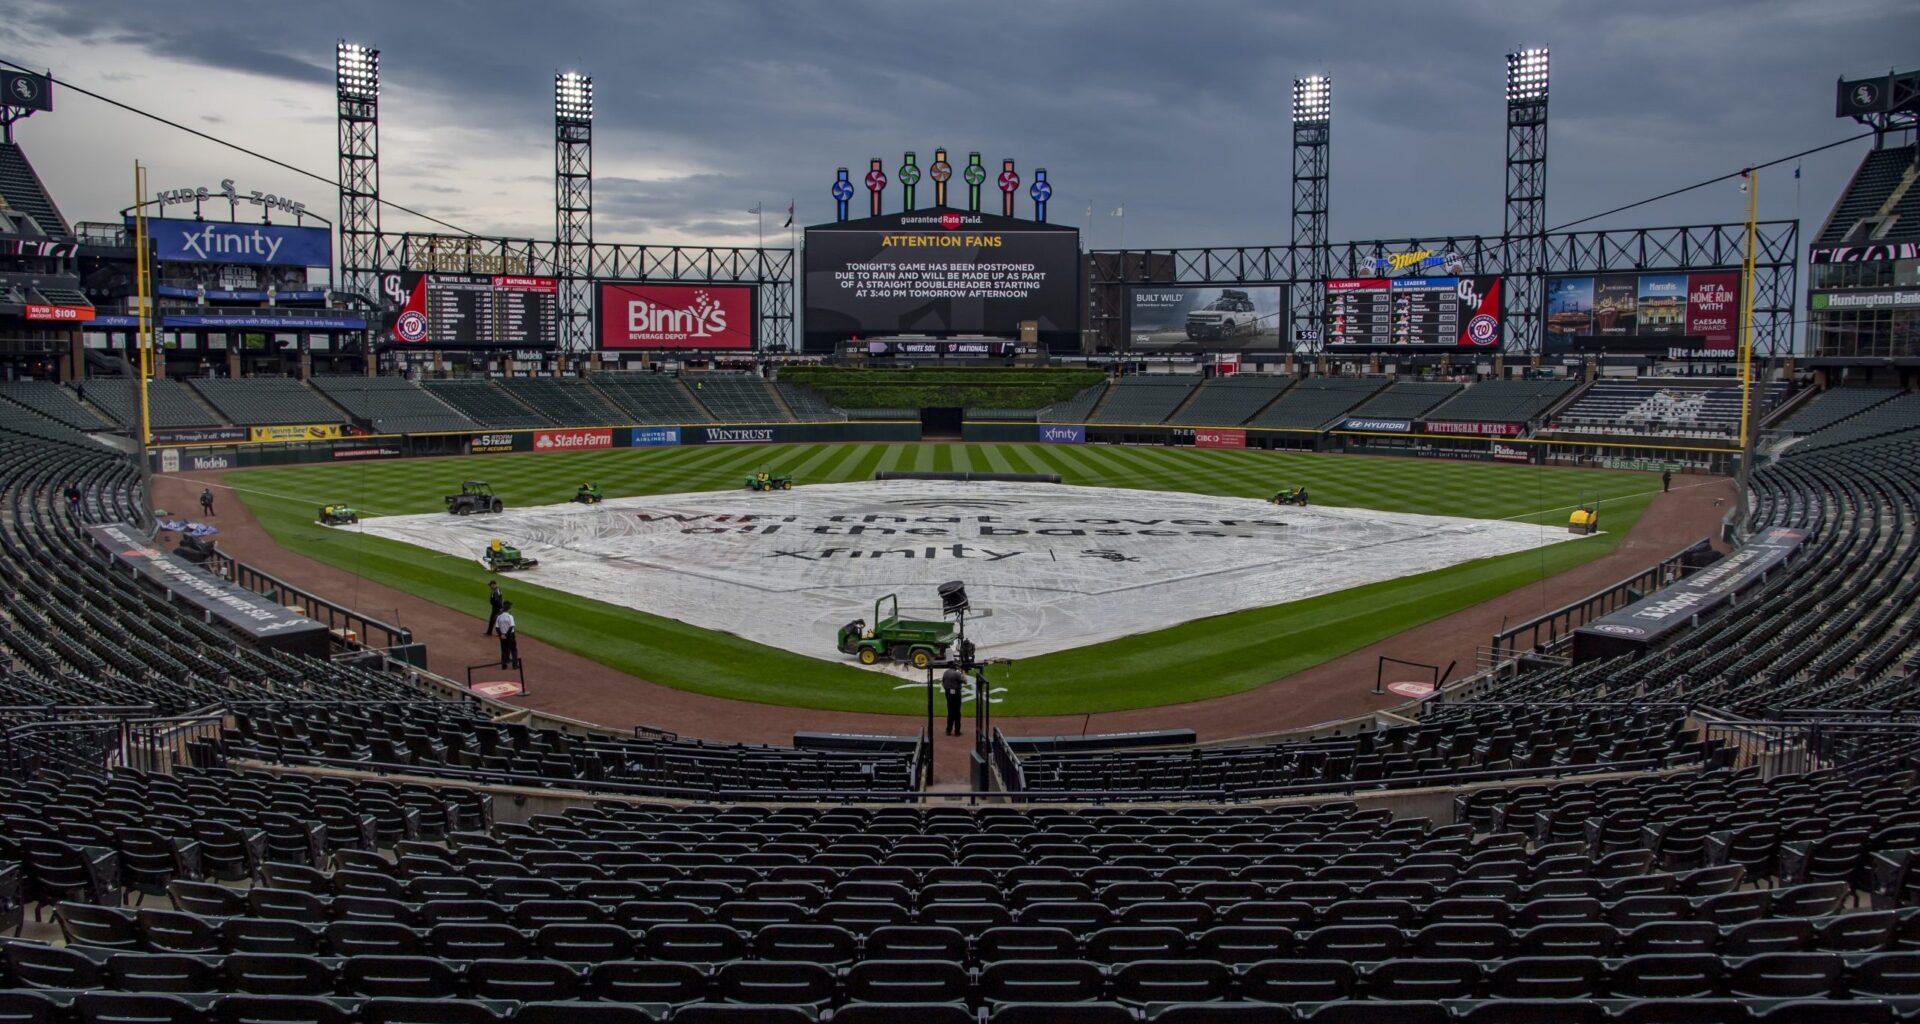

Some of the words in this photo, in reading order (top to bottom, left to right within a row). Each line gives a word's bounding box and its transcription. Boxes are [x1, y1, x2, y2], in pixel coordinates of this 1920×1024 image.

[157, 186, 210, 207] KIDS
[250, 190, 306, 217] ZONE
[901, 216, 942, 225] guaranteed
[182, 225, 283, 262] xfinity
[415, 236, 482, 250] CAESARS
[882, 236, 962, 247] ATTENTION
[966, 236, 1002, 248] FANS
[414, 252, 527, 275] SPORTSBOOK
[1388, 250, 1435, 271] Miller
[846, 263, 896, 271] TONIGHT'S
[898, 263, 926, 271] GAME
[928, 263, 948, 271] HAS
[950, 263, 976, 271] BEEN
[977, 263, 1035, 272] POSTPONED
[835, 272, 855, 280] DUE
[857, 272, 870, 280] TO
[872, 272, 896, 280] RAIN
[898, 272, 918, 280] AND
[921, 272, 946, 280] WILL
[948, 272, 960, 280] BE
[962, 272, 990, 280] MADE
[992, 272, 1005, 280] UP
[1007, 272, 1020, 280] AS
[1022, 272, 1046, 280] PART
[841, 281, 854, 289] OF
[856, 281, 864, 289] A
[866, 281, 912, 289] STRAIGHT
[915, 281, 992, 289] DOUBLEHEADER
[994, 281, 1040, 289] STARTING
[1700, 284, 1714, 292] HIT
[1716, 284, 1724, 292] A
[856, 290, 868, 298] AT
[870, 290, 891, 298] 3:40
[893, 290, 907, 298] PM
[909, 290, 966, 298] TOMORROW
[968, 290, 1028, 298] AFTERNOON
[1136, 294, 1159, 302] BUILT
[1690, 292, 1714, 303] HOME
[1716, 292, 1733, 302] RUN
[1829, 294, 1893, 308] Huntington
[1698, 303, 1723, 311] WITH
[55, 309, 76, 318] $100
[628, 300, 727, 337] Binny's
[106, 318, 128, 326] xfinity
[1302, 331, 1317, 339] 5:50
[516, 350, 542, 360] Modelo
[1691, 348, 1735, 358] LANDING
[1363, 422, 1405, 430] HYUNDAI
[1427, 422, 1478, 433] WHITTINGHAM
[1482, 424, 1507, 434] MEATS
[175, 431, 202, 442] Through
[706, 428, 773, 440] WINTRUST
[1045, 427, 1078, 440] xfinity
[1196, 434, 1212, 442] CIBC
[482, 435, 490, 446] 5
[1494, 444, 1528, 456] Rate.com
[194, 457, 228, 470] Modelo
[829, 514, 1003, 524] that
[1027, 517, 1290, 527] covers
[681, 525, 782, 535] all
[806, 526, 949, 536] the
[980, 526, 1254, 538] bases.
[762, 544, 1025, 562] xfinity
